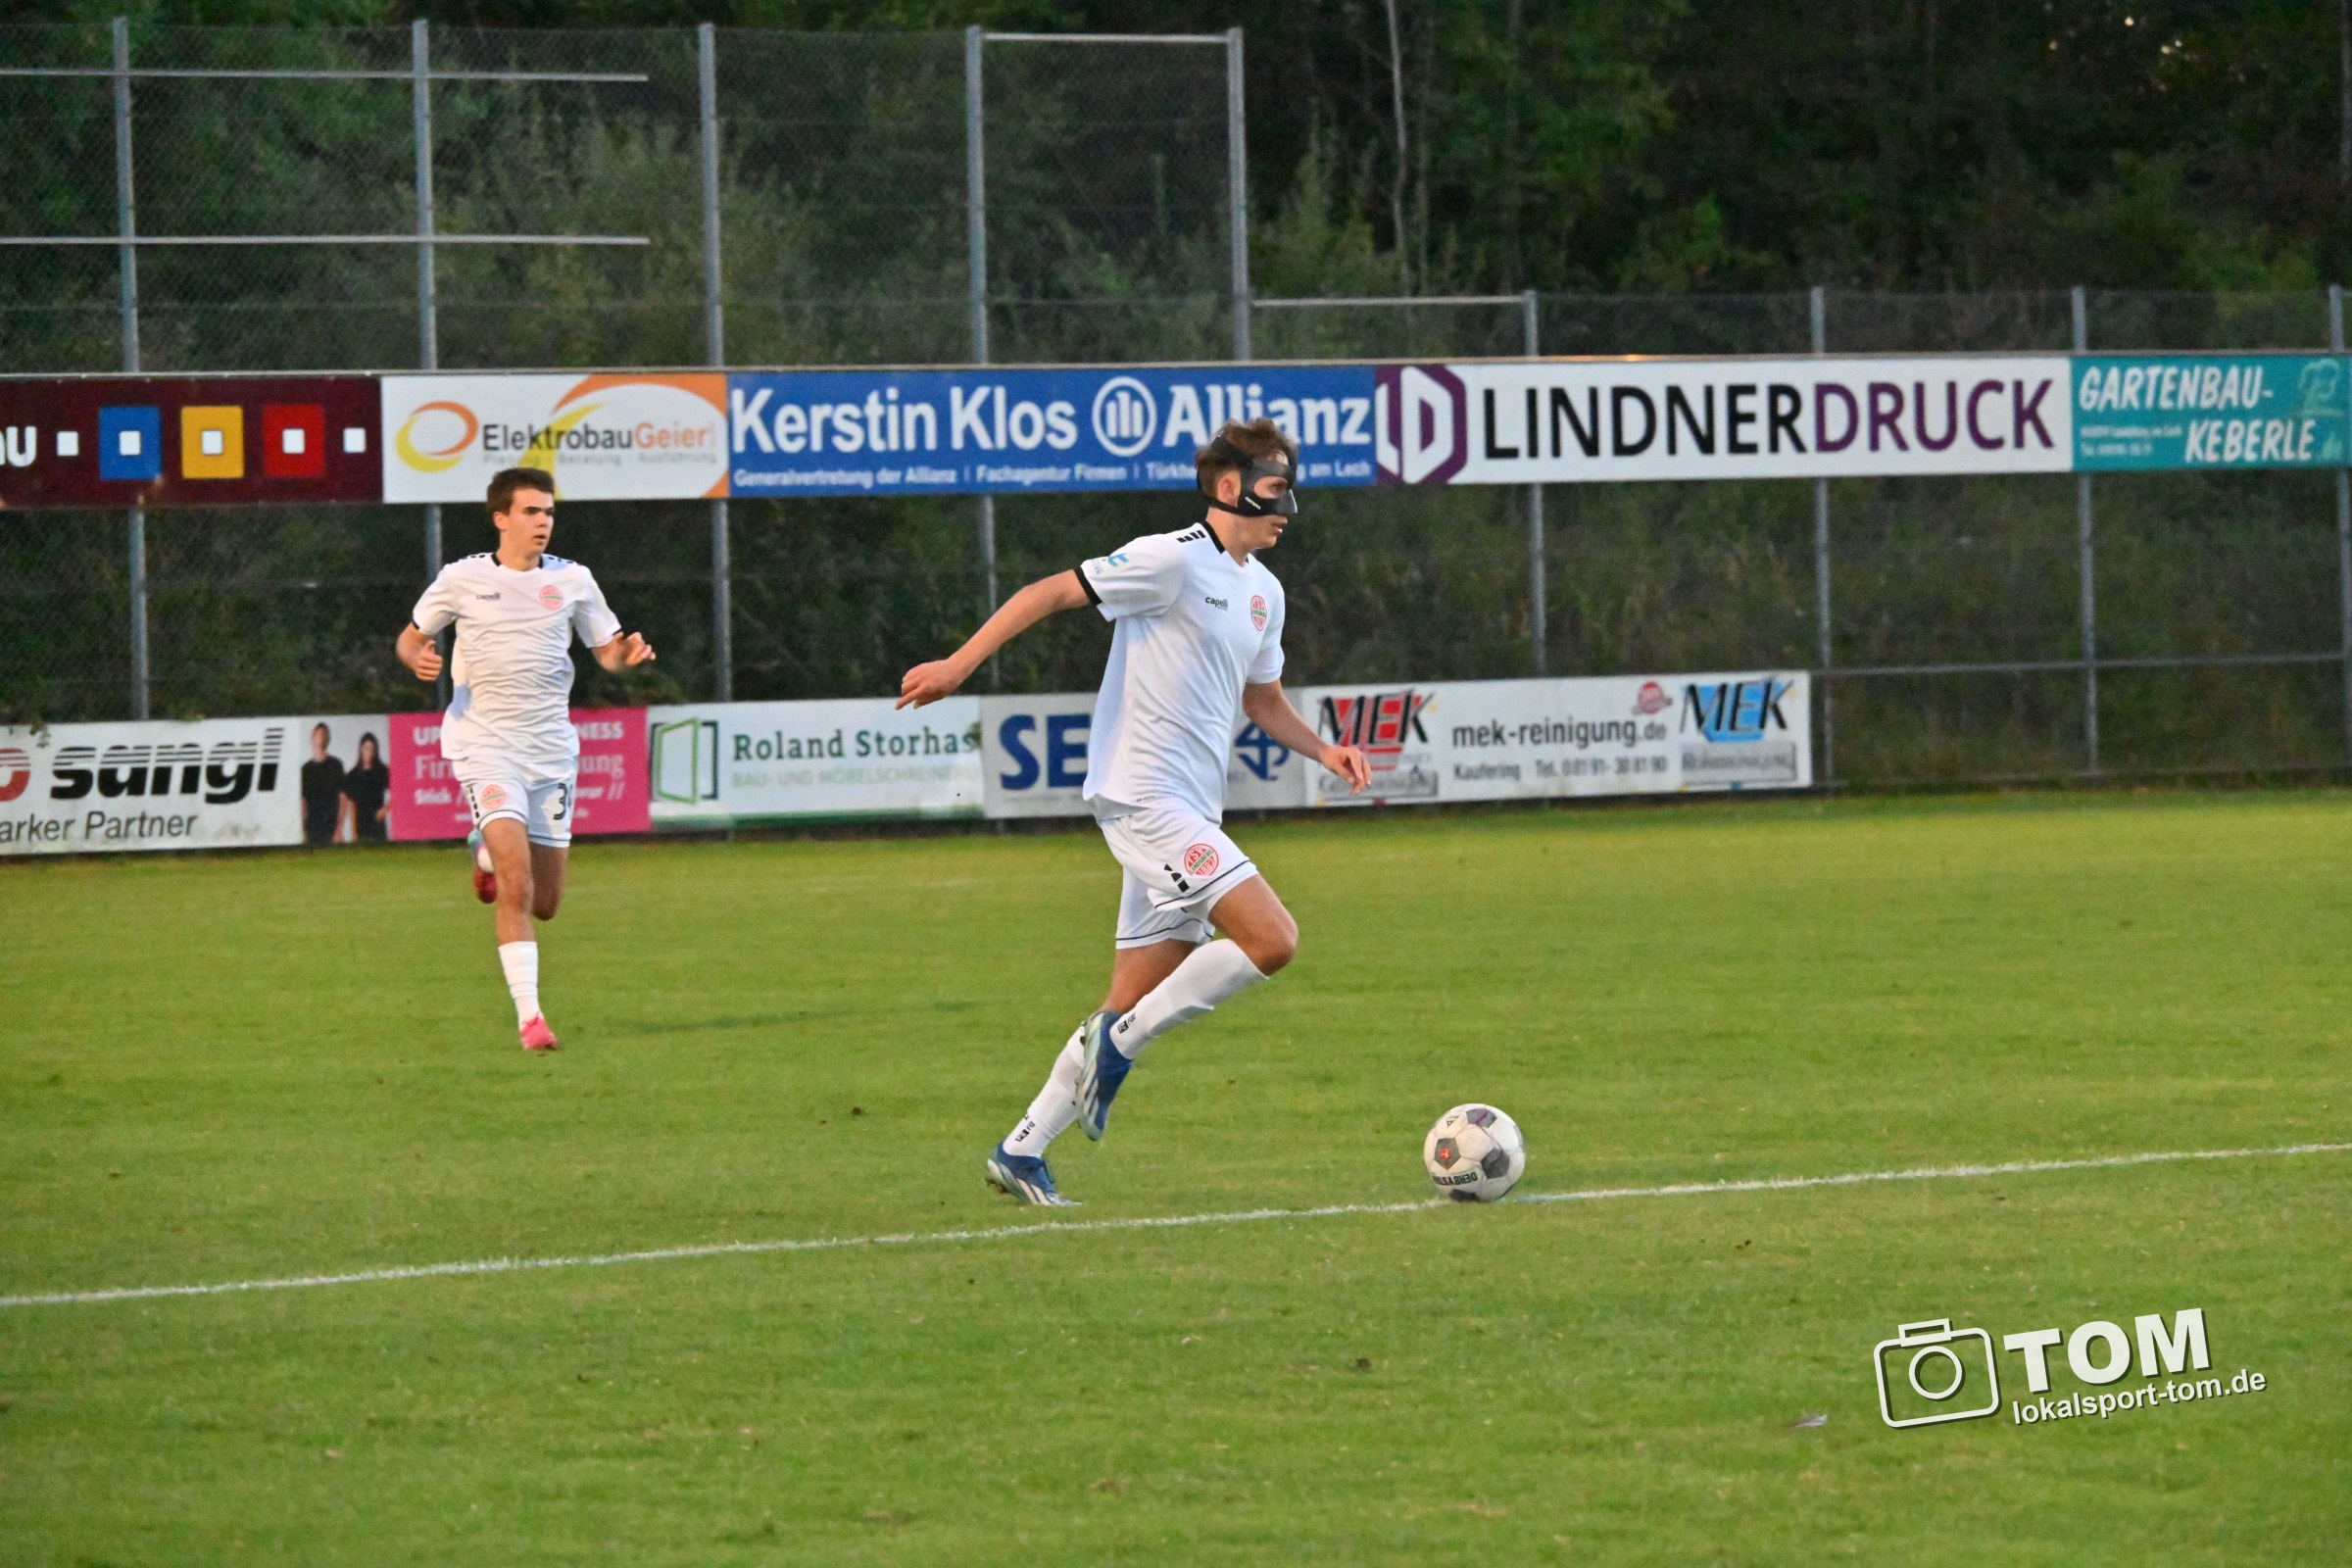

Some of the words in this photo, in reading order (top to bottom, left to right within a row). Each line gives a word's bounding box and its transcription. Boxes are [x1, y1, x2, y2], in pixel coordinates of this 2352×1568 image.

[2080, 365, 2274, 412] GARTENBAU-
[731, 387, 937, 453] Kerstin
[951, 385, 1077, 450] Klos
[1162, 383, 1371, 447] Allianz
[1483, 378, 2054, 461] LINDNERDRUCK
[2185, 418, 2317, 464] KEBERLE
[1318, 689, 1435, 745] MEK
[1680, 676, 1793, 732] MEK
[733, 728, 845, 761] Roland
[999, 713, 1091, 790] SE
[1452, 716, 1667, 749] mek-reinigung.de
[0, 812, 74, 844] arker
[85, 810, 198, 841] Partner
